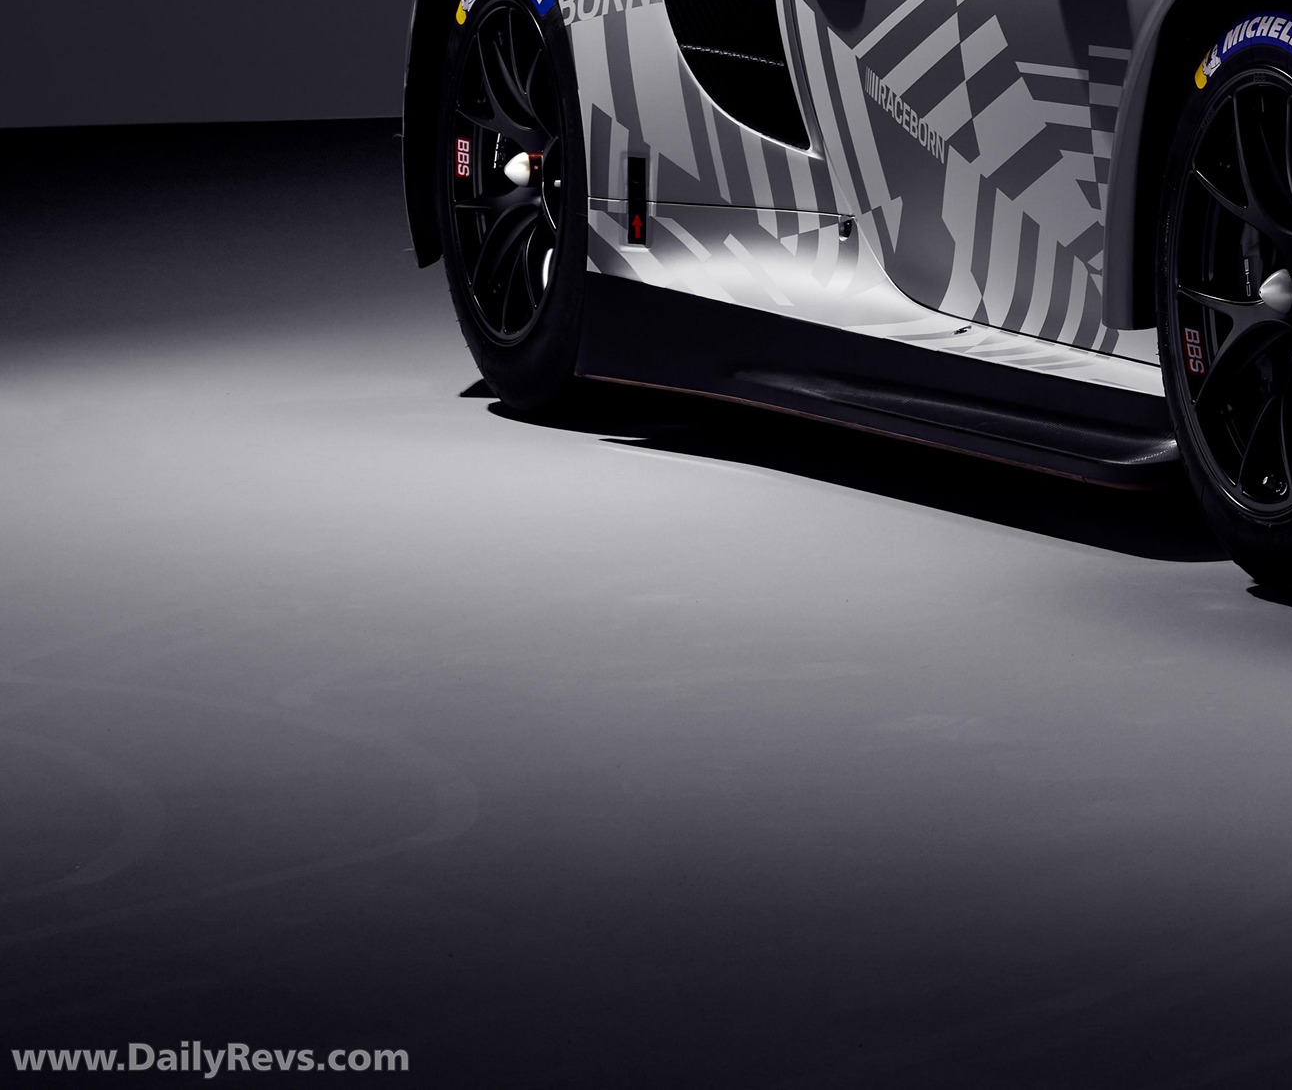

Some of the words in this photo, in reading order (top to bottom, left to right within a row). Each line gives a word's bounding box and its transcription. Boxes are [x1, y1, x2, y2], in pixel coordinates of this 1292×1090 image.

[878, 79, 945, 164] RACEBORN
[456, 138, 471, 178] BBS
[1184, 326, 1205, 375] BBS
